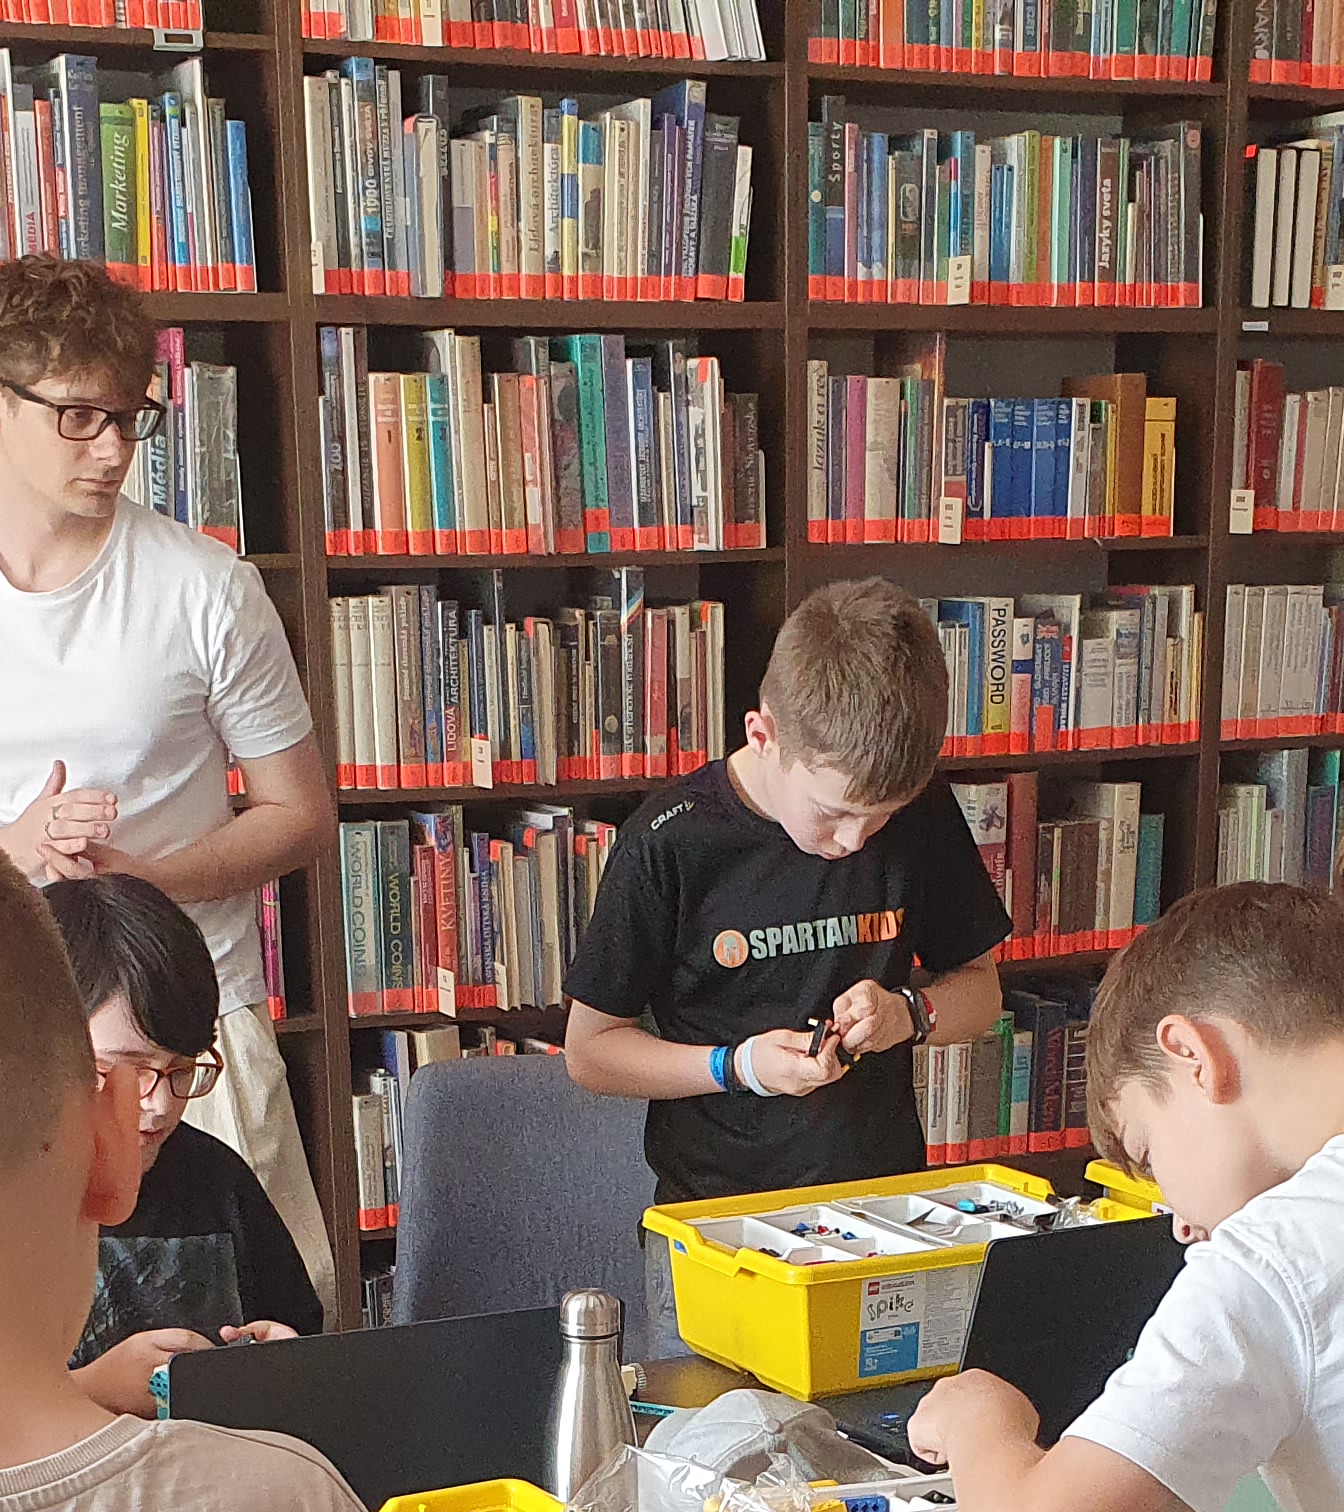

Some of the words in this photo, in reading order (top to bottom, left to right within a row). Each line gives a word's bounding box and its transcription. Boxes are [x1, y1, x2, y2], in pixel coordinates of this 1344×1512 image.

[71, 105, 89, 196] management
[828, 120, 843, 182] Sporty
[110, 132, 130, 233] Marketing
[363, 178, 378, 213] 1000
[1100, 178, 1112, 217] sveta
[75, 198, 93, 259] arketing
[1098, 219, 1112, 269] Jazyky
[151, 433, 169, 506] Média
[812, 419, 826, 472] Jazyk
[990, 607, 1007, 705] PASSWORD
[444, 705, 457, 752] LIDOVÁ
[650, 801, 685, 831] CRAFT
[350, 840, 364, 909] WORLD
[388, 872, 402, 935] WORLD
[390, 939, 404, 989] COINS
